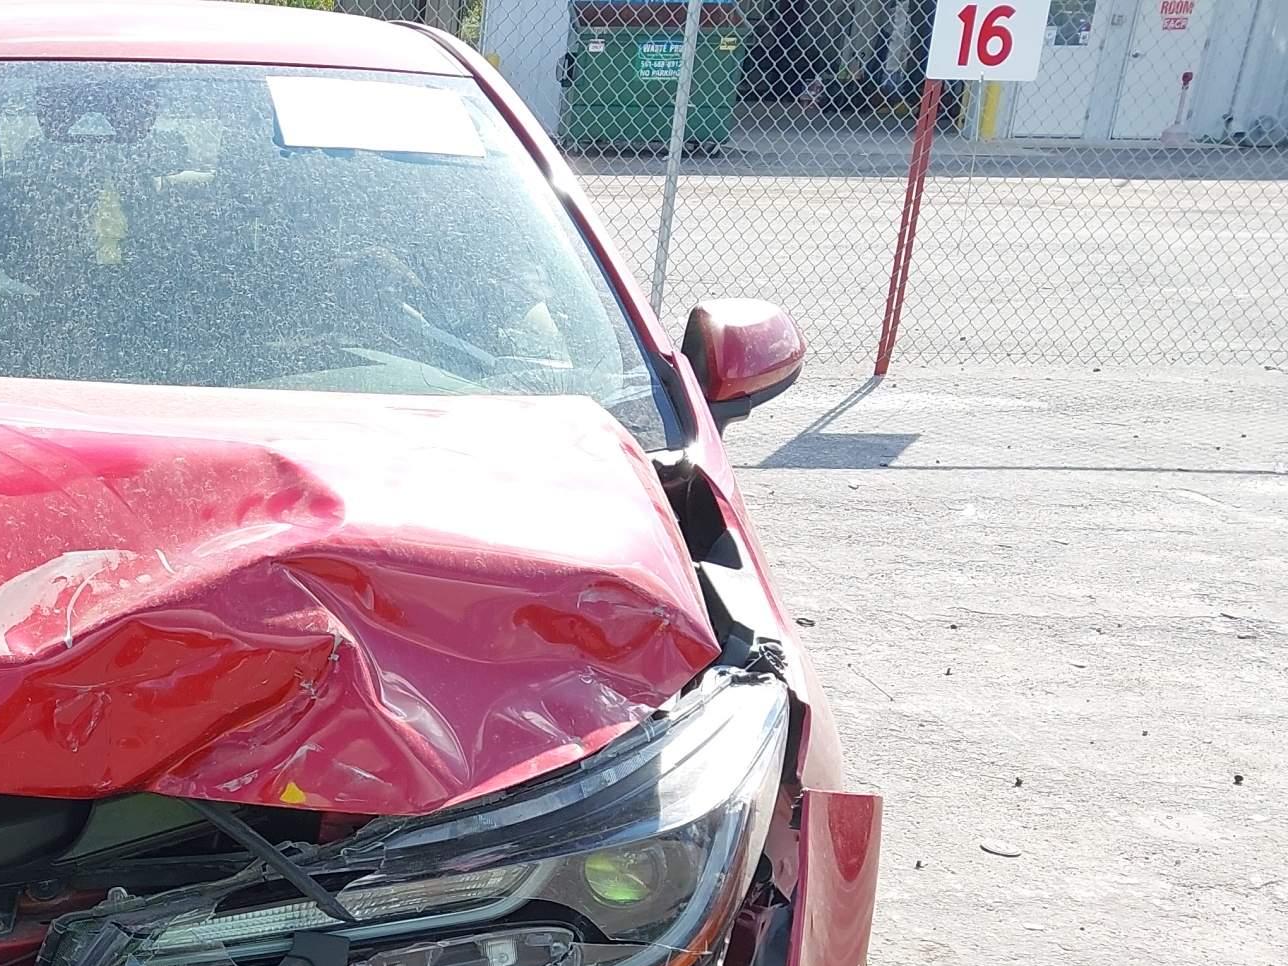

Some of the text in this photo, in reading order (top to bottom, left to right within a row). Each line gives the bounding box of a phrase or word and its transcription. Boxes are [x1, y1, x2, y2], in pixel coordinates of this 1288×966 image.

[1160, 0, 1194, 15] ROOM
[957, 4, 1016, 66] 16
[642, 44, 667, 53] WASTE
[640, 69, 650, 77] NO
